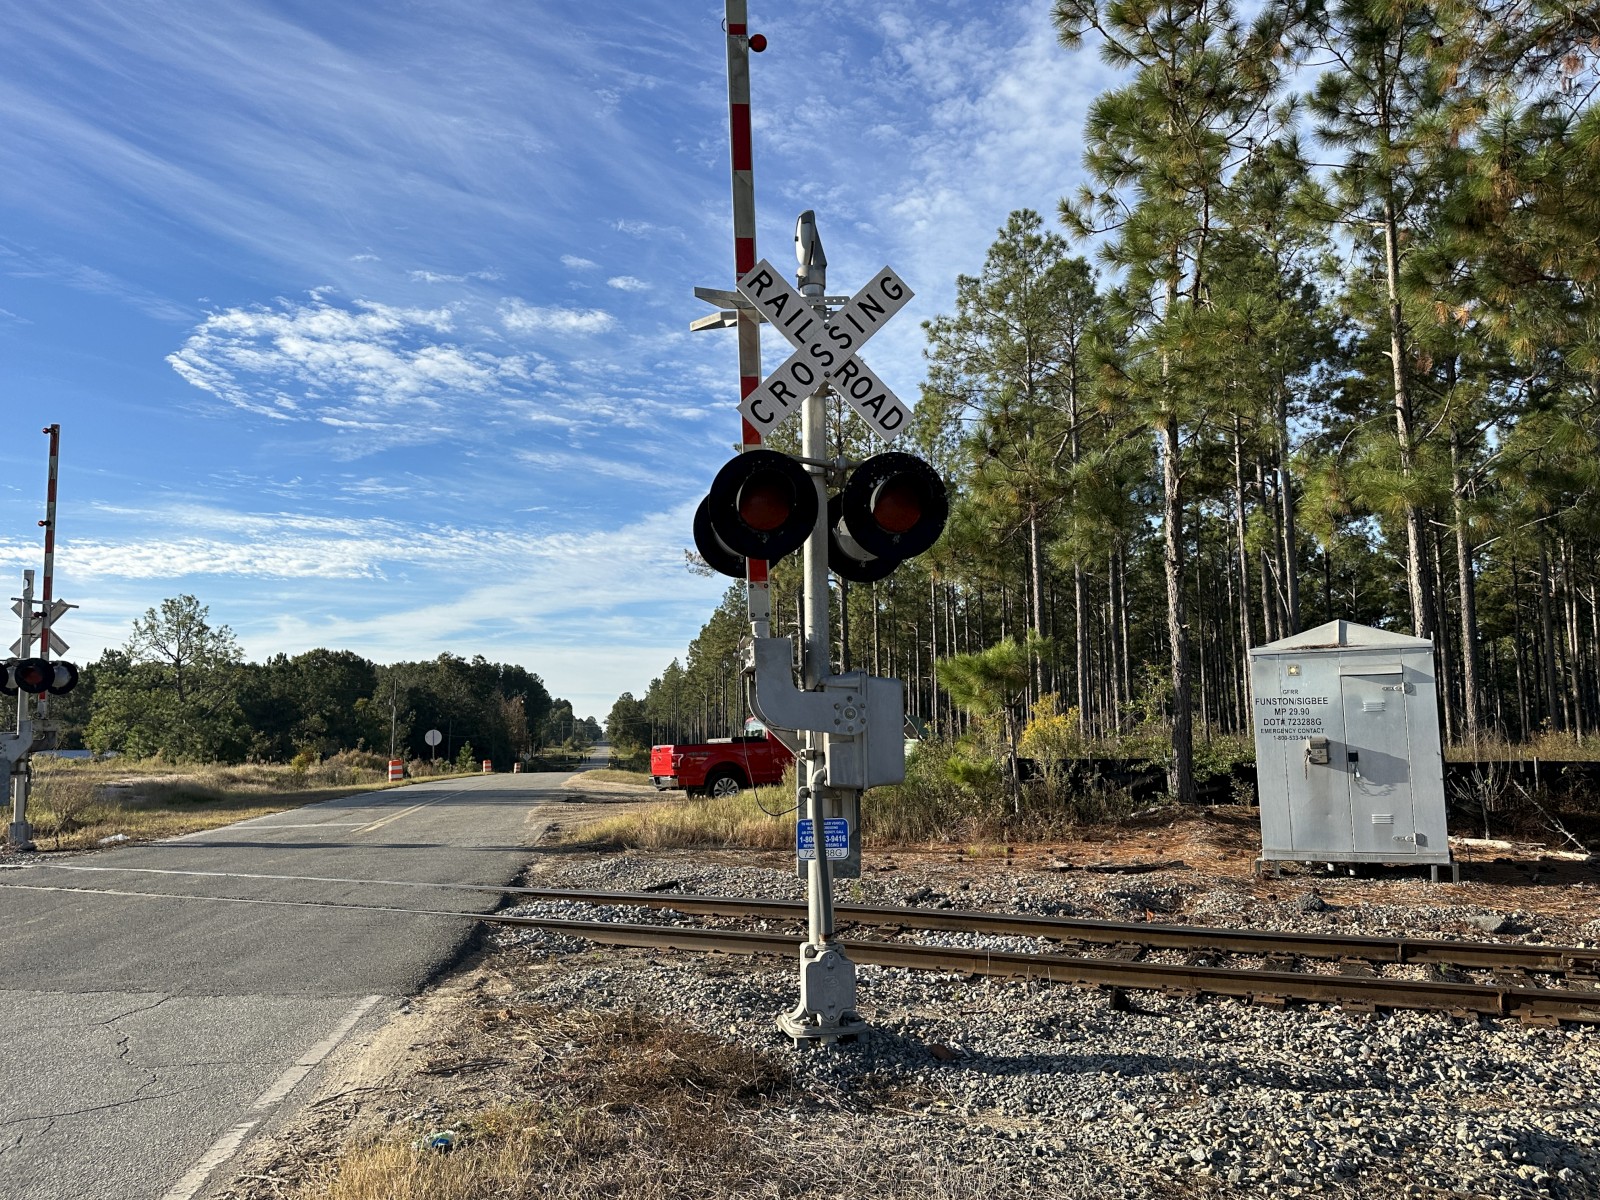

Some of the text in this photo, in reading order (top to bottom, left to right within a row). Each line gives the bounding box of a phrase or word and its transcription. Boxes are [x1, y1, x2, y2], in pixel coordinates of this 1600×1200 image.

[747, 269, 904, 431] RAIL ROAD
[750, 276, 903, 424] CROSSING
[1255, 697, 1329, 705] FUNSTON/SIGBEE
[1274, 707, 1310, 716] MP 29.90
[1263, 718, 1322, 726] DOT# 723288G
